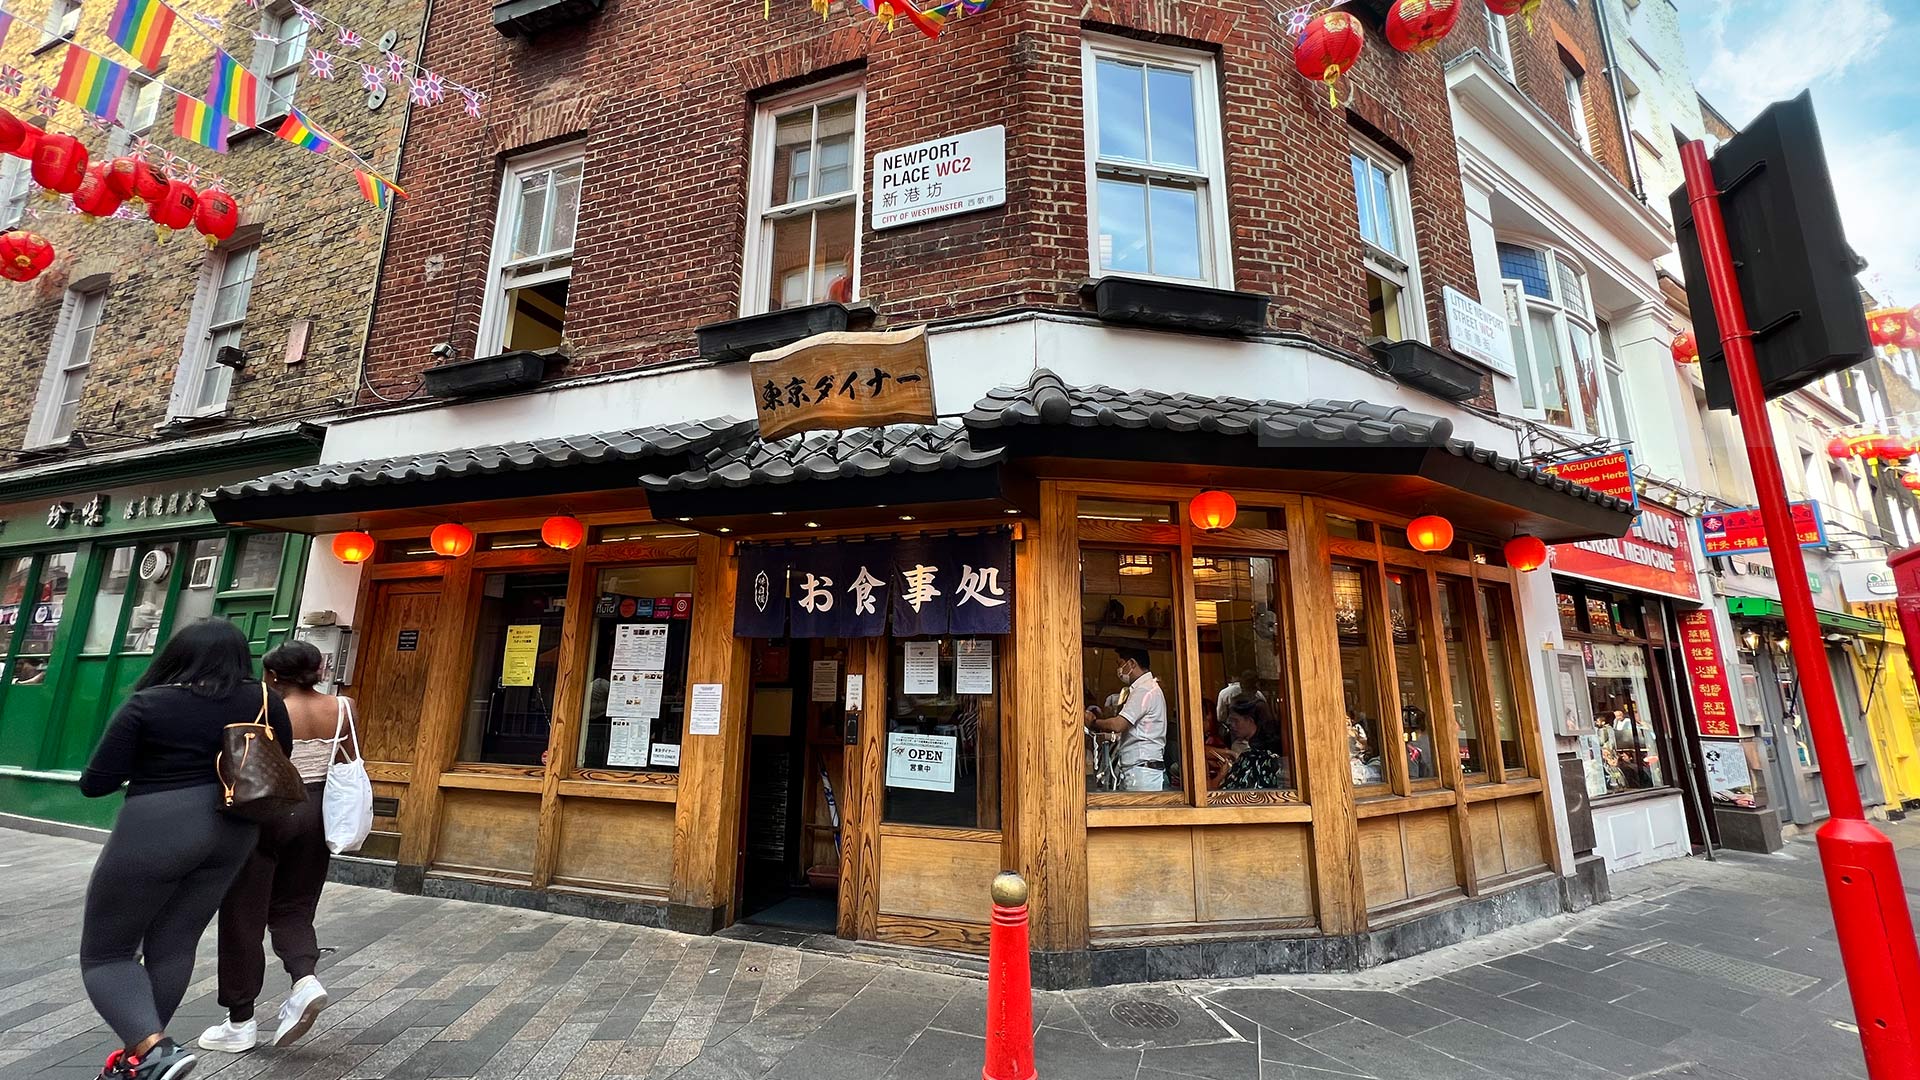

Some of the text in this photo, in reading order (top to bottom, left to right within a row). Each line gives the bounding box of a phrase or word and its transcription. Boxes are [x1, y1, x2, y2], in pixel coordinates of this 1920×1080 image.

[883, 141, 959, 171] NEWPORT
[883, 157, 972, 189] PLACE WC2
[882, 182, 943, 208] 新港坊
[882, 201, 964, 224] CITY OF WESTMINSTER
[1450, 293, 1505, 332] LITTLE NEWPORT
[1452, 308, 1478, 330] STREET
[762, 368, 922, 411] 東京ダイナー
[1562, 455, 1626, 473] Acupucture
[1571, 471, 1628, 485] hinese Herbs
[1573, 538, 1624, 559] ERBAL
[1623, 541, 1677, 573] MEDICINE
[798, 564, 1006, 616] お食事処
[908, 749, 943, 761] OPEN
